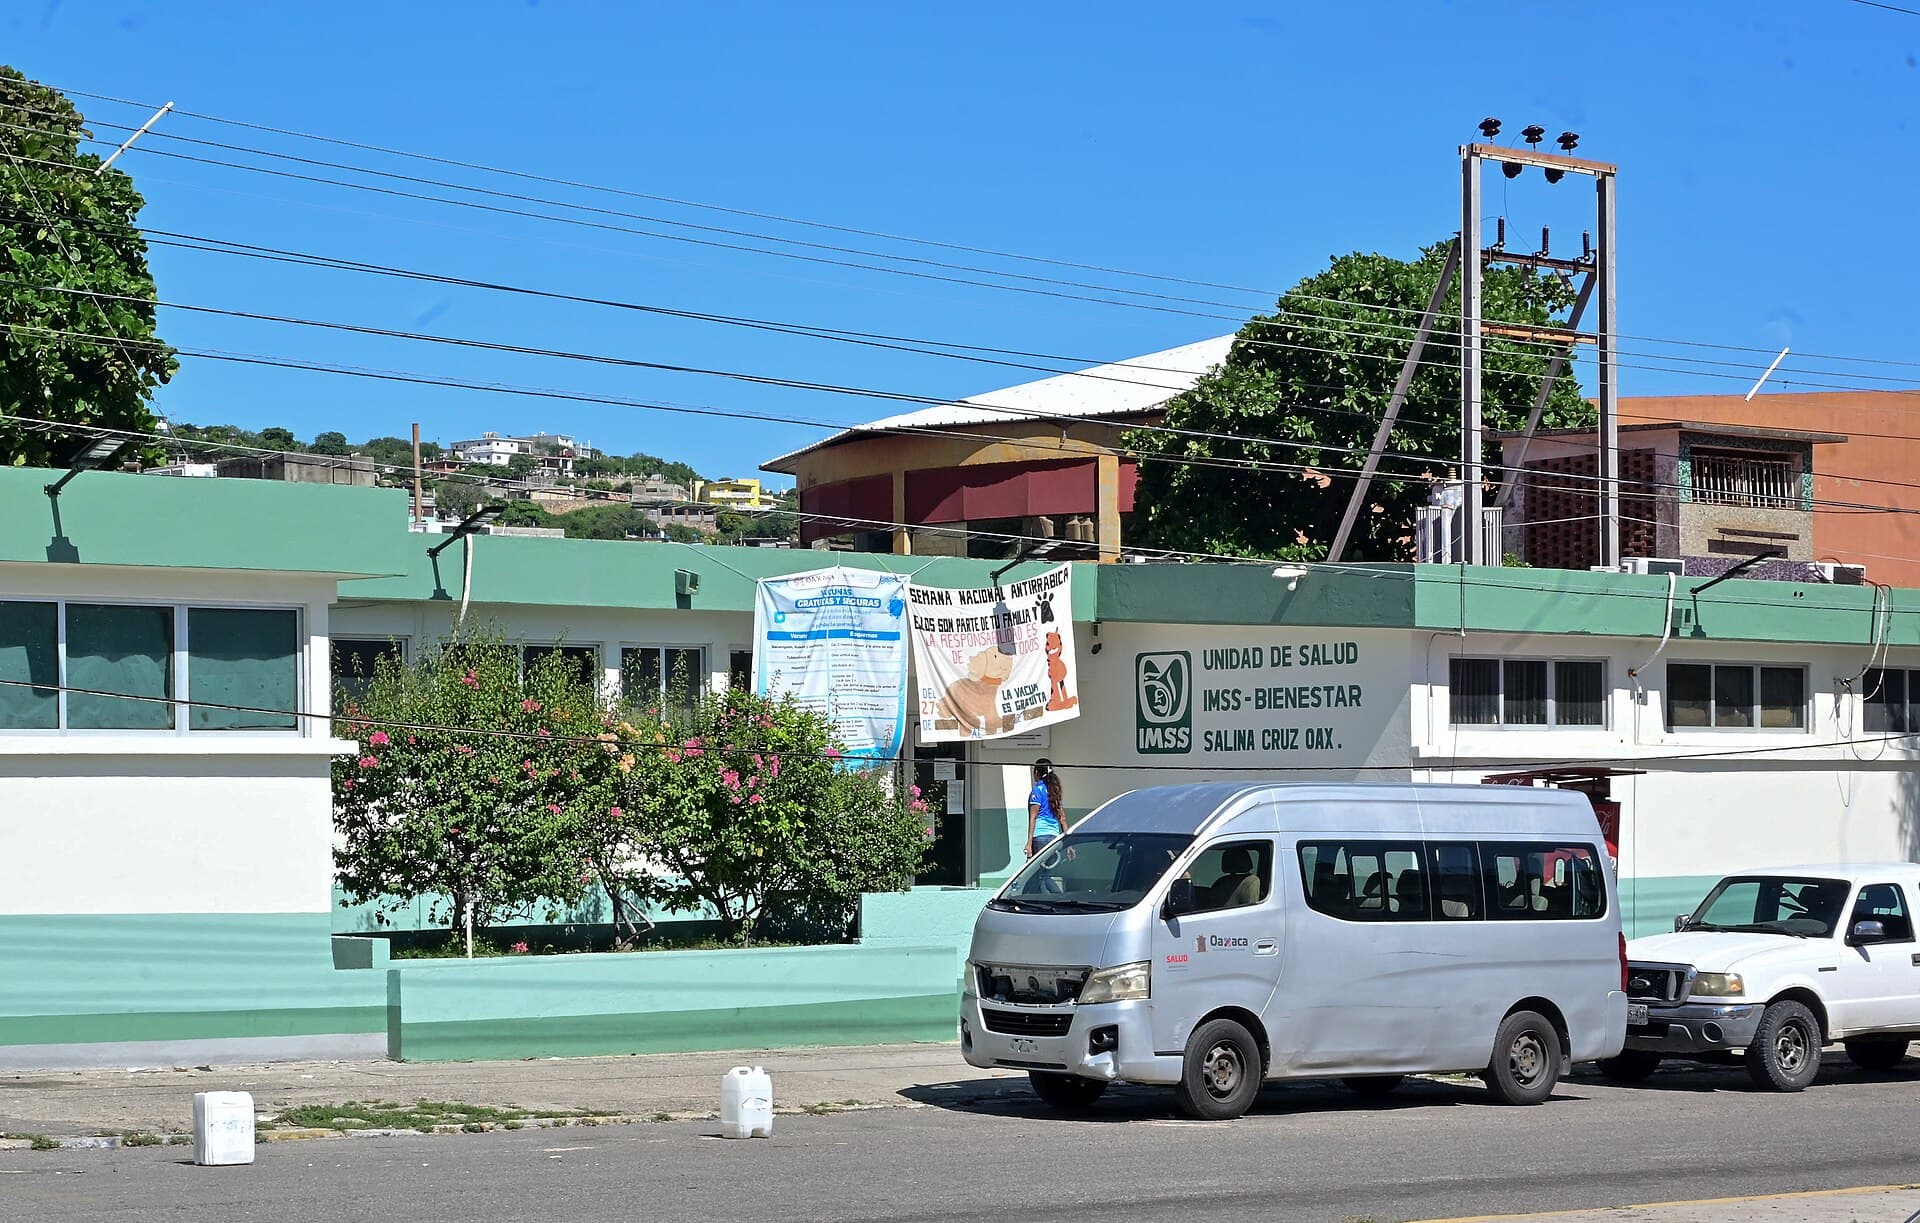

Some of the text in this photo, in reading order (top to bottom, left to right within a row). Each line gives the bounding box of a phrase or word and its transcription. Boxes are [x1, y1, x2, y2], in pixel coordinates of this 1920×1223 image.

[910, 567, 1069, 606] SEMANA NACIONAL ANTIRRABICA
[913, 606, 1037, 632] ELOS SON PARTE DE TU FAMILIA Y
[926, 622, 1038, 648] LA RESPONSABILIDAD ES
[952, 637, 1040, 664] DE TODOS
[1204, 642, 1358, 670] UNIDAD DE SALUD
[922, 688, 936, 699] DEL
[1002, 682, 1039, 700] LA VACUN
[1204, 684, 1362, 712] IMSS-BIENESTAR
[922, 701, 935, 715] 27
[1002, 702, 1012, 714] ES
[922, 720, 932, 730] DE
[1138, 726, 1190, 750] IMSS
[1204, 728, 1342, 752] SALINA CRUZ OAX.
[1210, 935, 1248, 947] Oaxaca
[1166, 954, 1188, 962] SALUD
